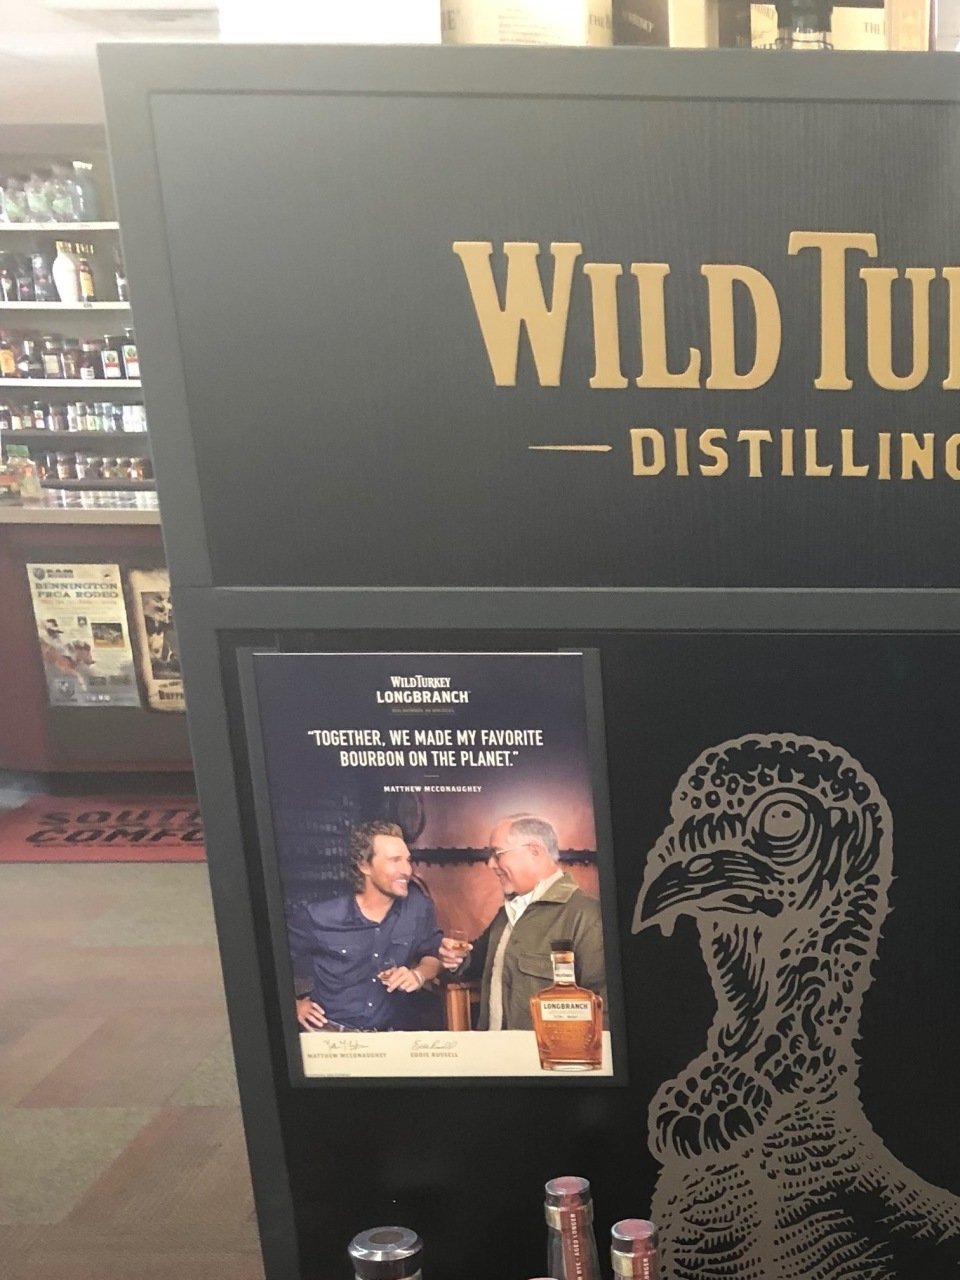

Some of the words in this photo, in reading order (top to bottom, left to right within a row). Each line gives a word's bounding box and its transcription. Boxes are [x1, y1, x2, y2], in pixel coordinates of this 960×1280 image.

[453, 241, 783, 390] WILD
[390, 676, 417, 688] WILD
[415, 674, 451, 689] TURKEY
[376, 690, 469, 703] LONGBRANCH
[389, 730, 411, 746] WE
[415, 730, 452, 746] MADE
[457, 730, 476, 746] MY
[481, 730, 543, 746] FAVORITE
[340, 751, 405, 767] BOURBON
[409, 751, 428, 767] ON
[431, 751, 456, 767] THE
